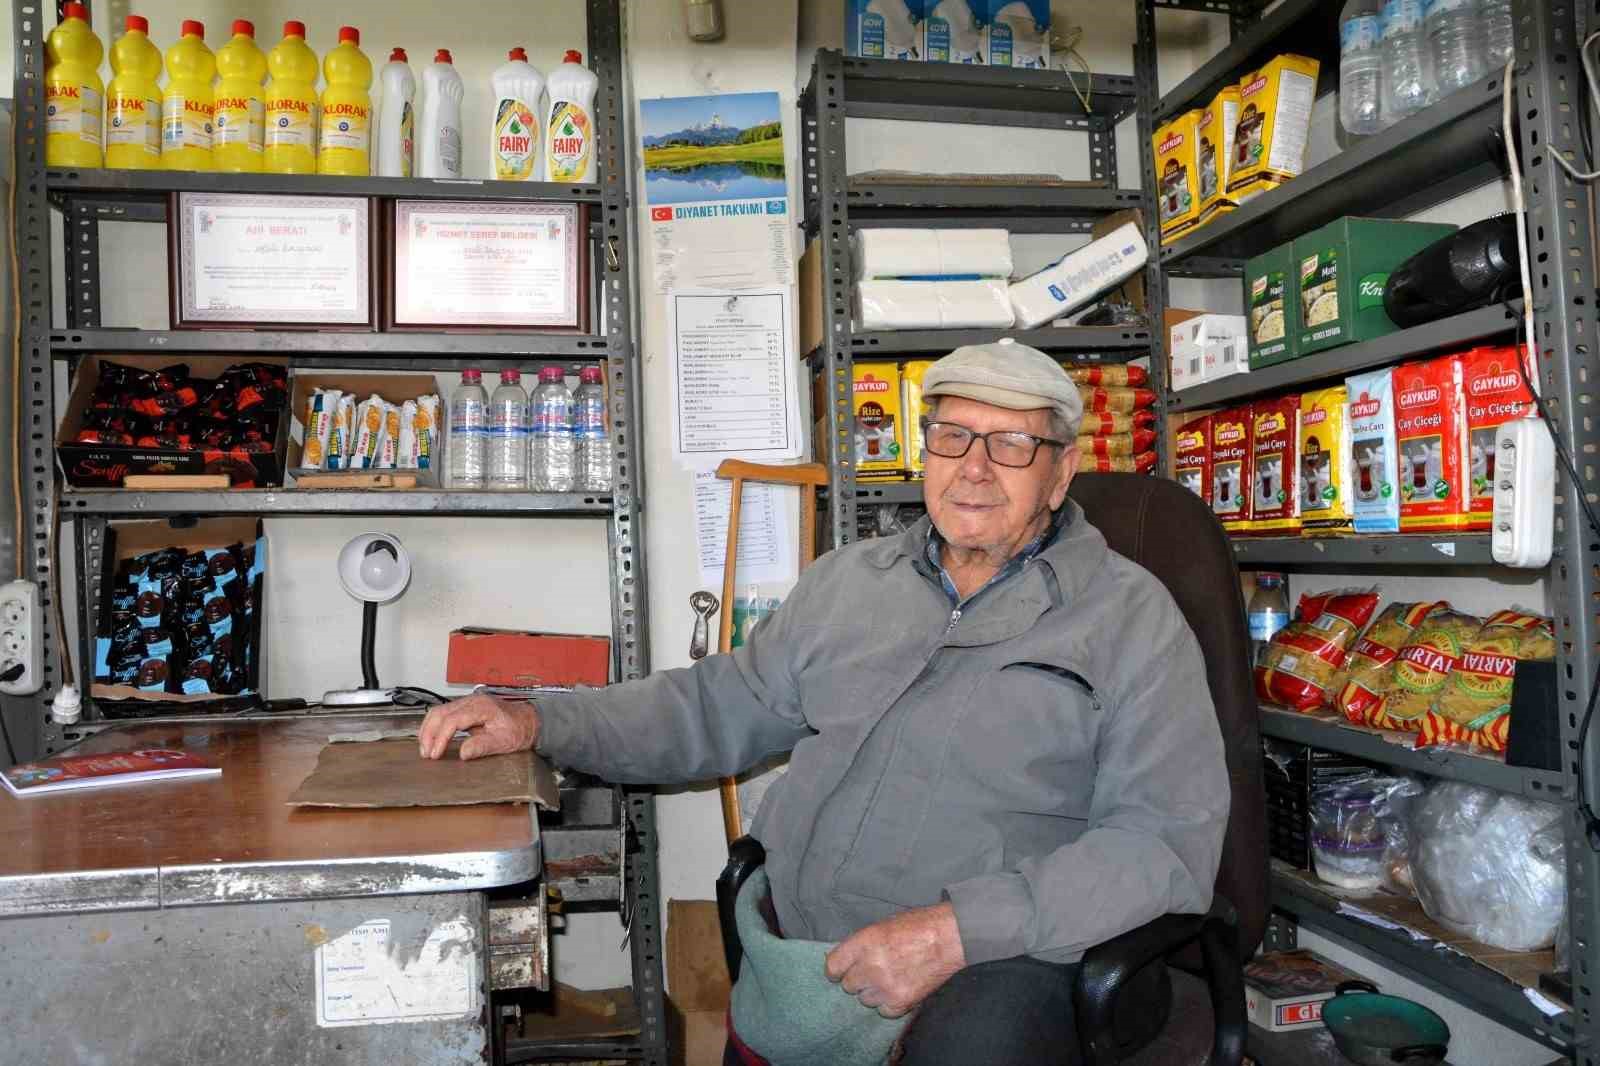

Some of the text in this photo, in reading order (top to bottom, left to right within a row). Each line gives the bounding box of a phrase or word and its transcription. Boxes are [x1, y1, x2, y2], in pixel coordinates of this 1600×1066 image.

[323, 103, 368, 119] KLORAK
[500, 136, 530, 153] FAIRY
[553, 138, 584, 154] FAIRY
[1463, 653, 1517, 675] KARTAL
